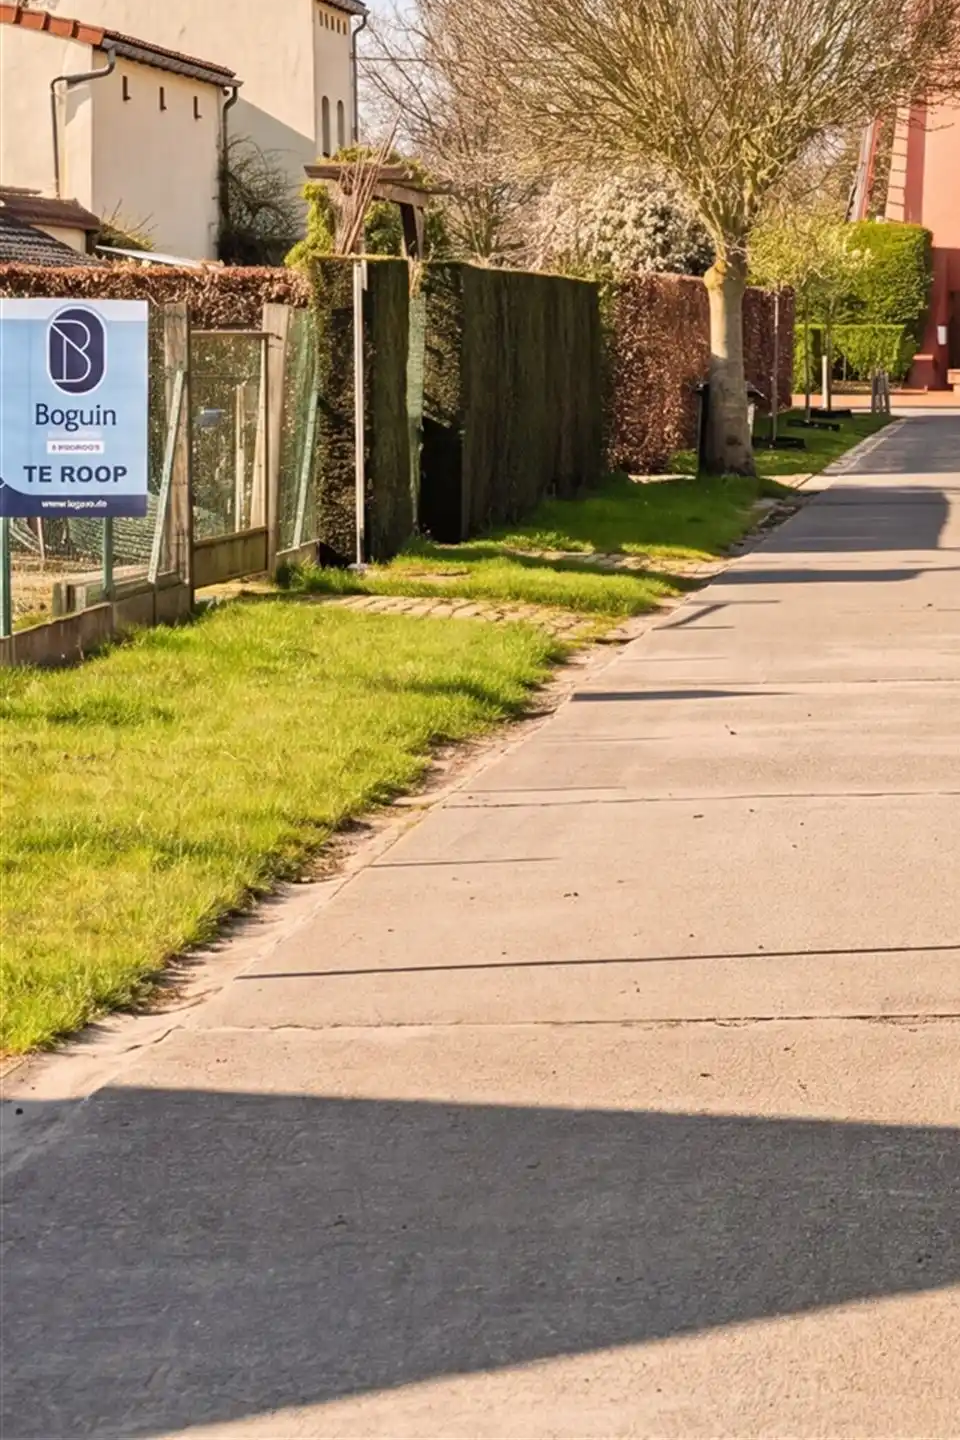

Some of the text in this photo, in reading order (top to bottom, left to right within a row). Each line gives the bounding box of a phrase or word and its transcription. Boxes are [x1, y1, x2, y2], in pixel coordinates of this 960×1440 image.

[35, 403, 117, 432] Boguin
[23, 466, 128, 483] TE ROOP
